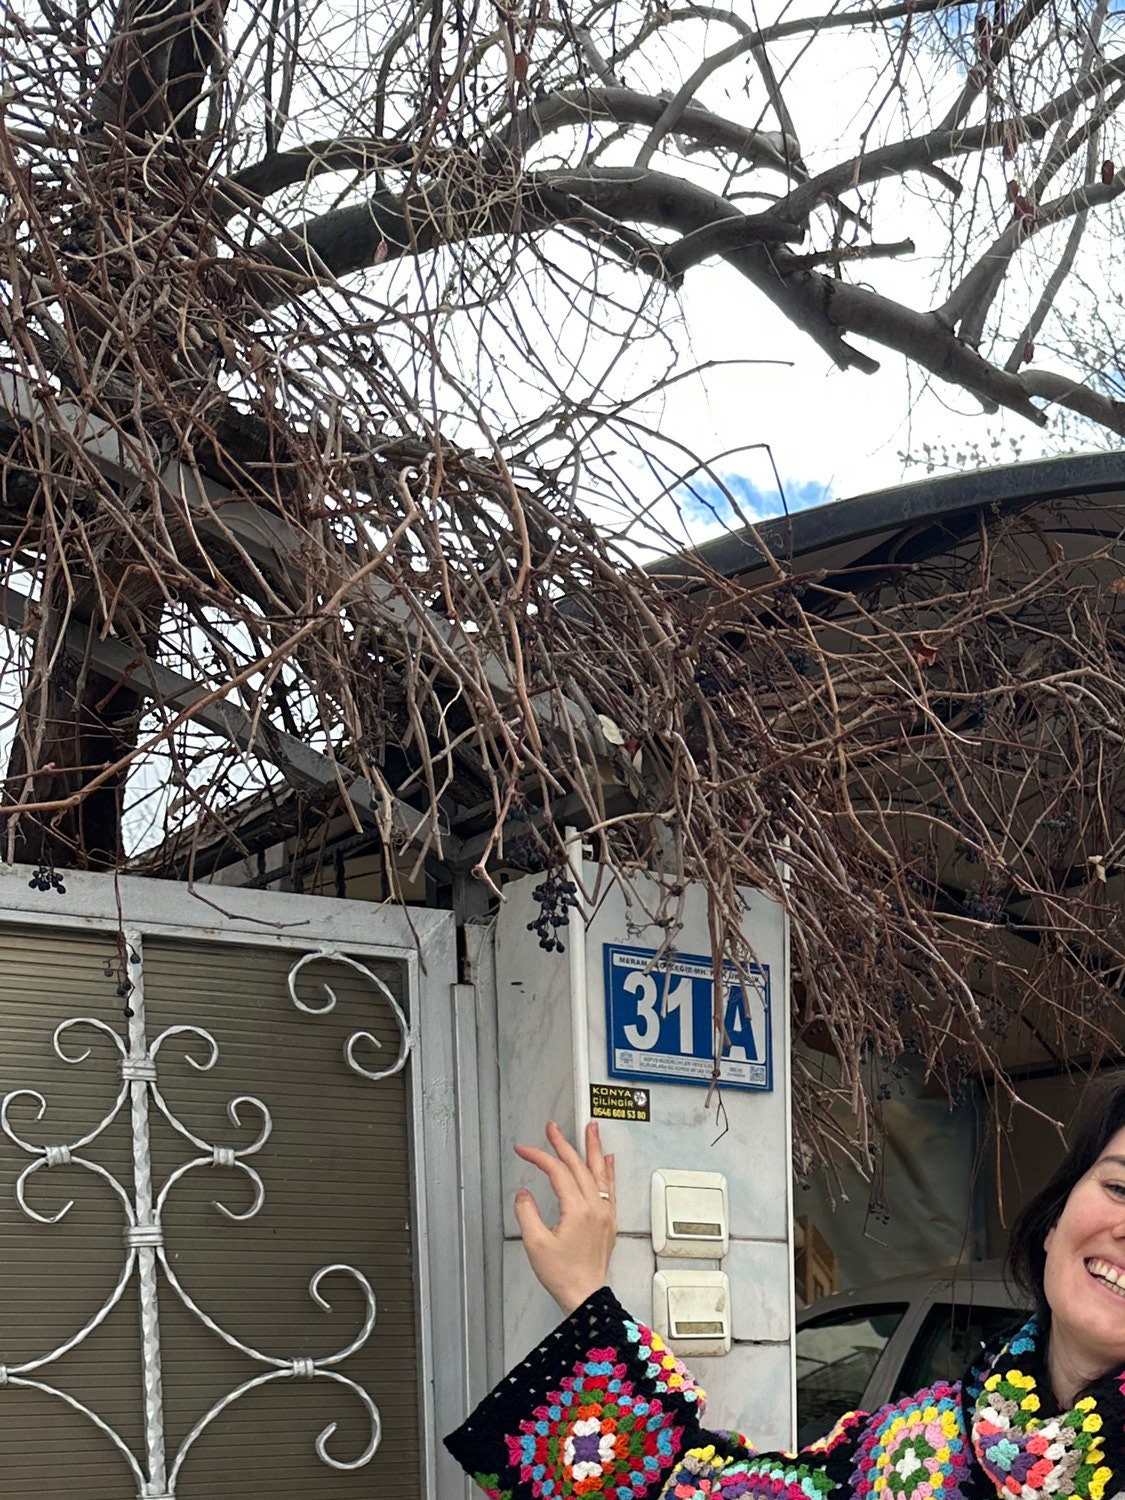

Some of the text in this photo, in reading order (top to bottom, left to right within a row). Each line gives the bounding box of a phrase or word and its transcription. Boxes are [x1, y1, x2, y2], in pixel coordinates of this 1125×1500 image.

[619, 957, 648, 967] MERAM
[623, 971, 758, 1061] 31 A
[592, 1087, 632, 1097] KONYA
[592, 1095, 634, 1107] ÇİLİNGİR
[593, 1107, 611, 1117] 0546
